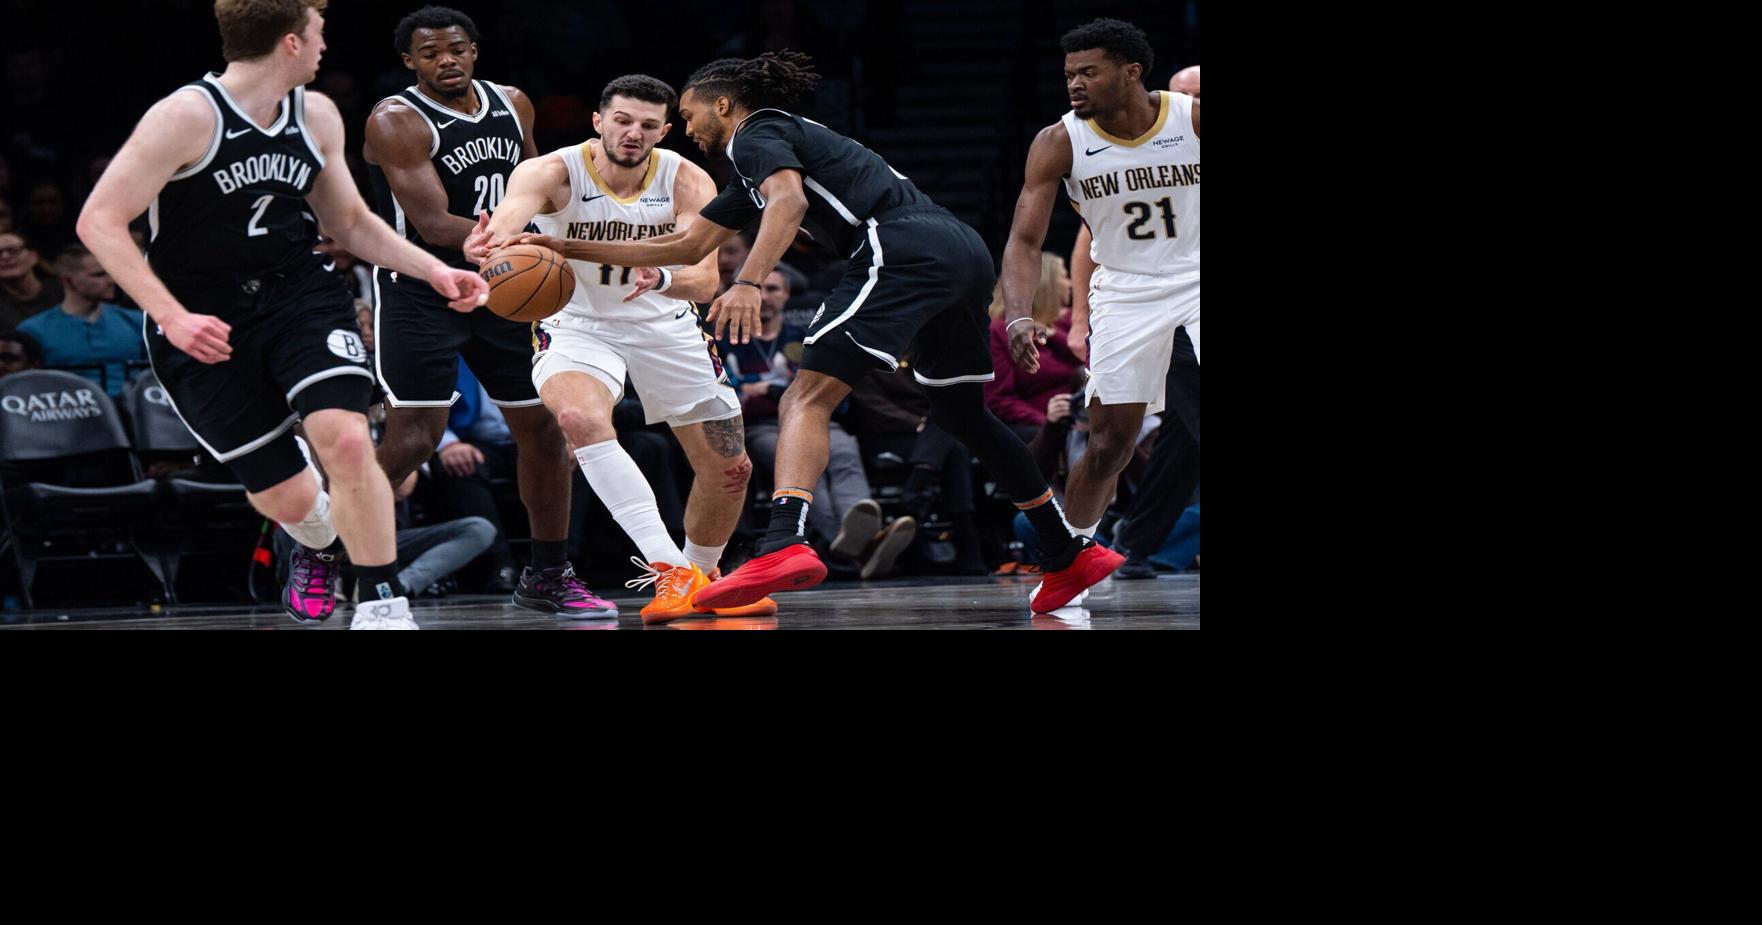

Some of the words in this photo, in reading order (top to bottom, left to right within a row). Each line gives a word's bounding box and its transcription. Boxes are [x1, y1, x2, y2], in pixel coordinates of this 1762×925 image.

[441, 137, 521, 175] BROOKLYN
[1153, 136, 1184, 146] NEWAGE
[213, 153, 312, 195] BROOKLYN
[1079, 171, 1119, 200] NEW
[1125, 164, 1200, 191] ORLEANS
[473, 173, 505, 216] 20
[640, 196, 670, 204] NEWAGE
[248, 195, 275, 237] 2
[566, 220, 606, 241] NEW
[607, 220, 676, 241] ORLEANS
[1123, 196, 1177, 240] 21
[1, 389, 96, 416] QATAR
[31, 407, 102, 422] AIRWAYS
